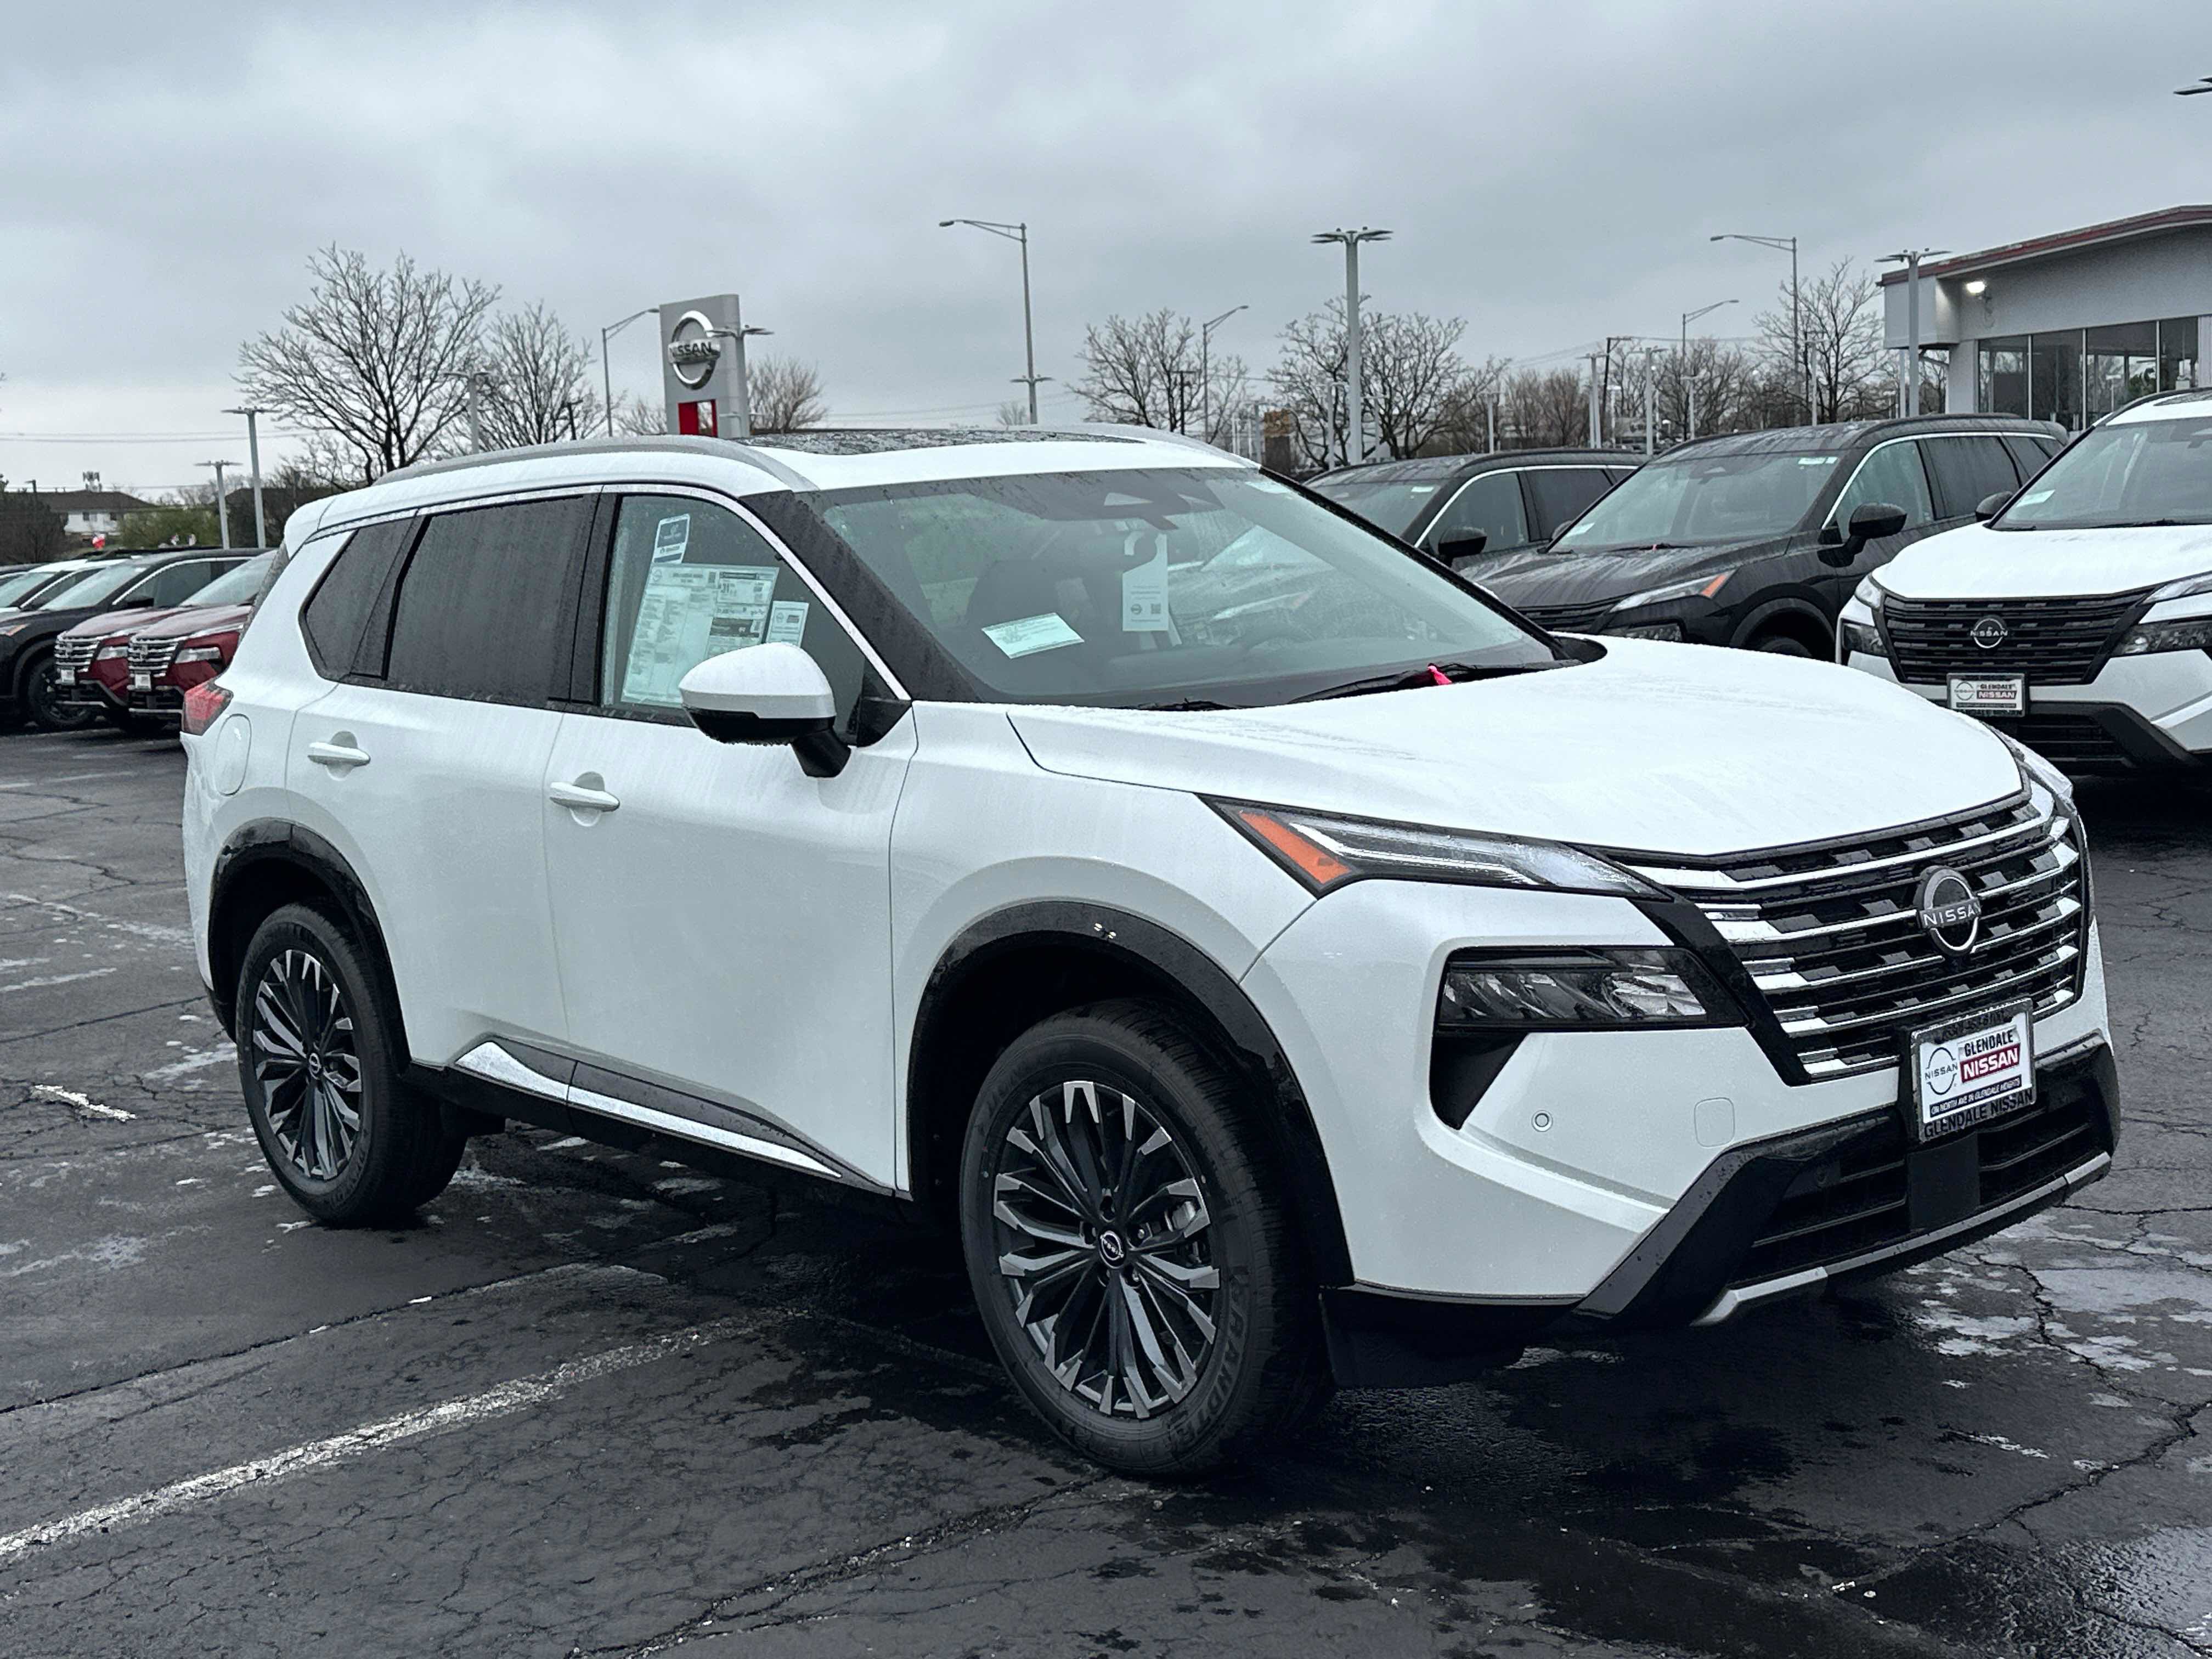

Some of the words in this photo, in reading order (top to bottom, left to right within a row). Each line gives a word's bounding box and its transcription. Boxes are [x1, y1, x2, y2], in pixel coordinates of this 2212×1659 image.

[1923, 902, 1982, 926] NISSAN
[1964, 1029, 2014, 1058] GLENDALE
[1924, 1062, 1958, 1080] NISSAN
[1962, 1048, 2019, 1080] NISSAN
[1923, 1103, 1989, 1138] GLENDALE
[1990, 1087, 2033, 1115] NISSAN
